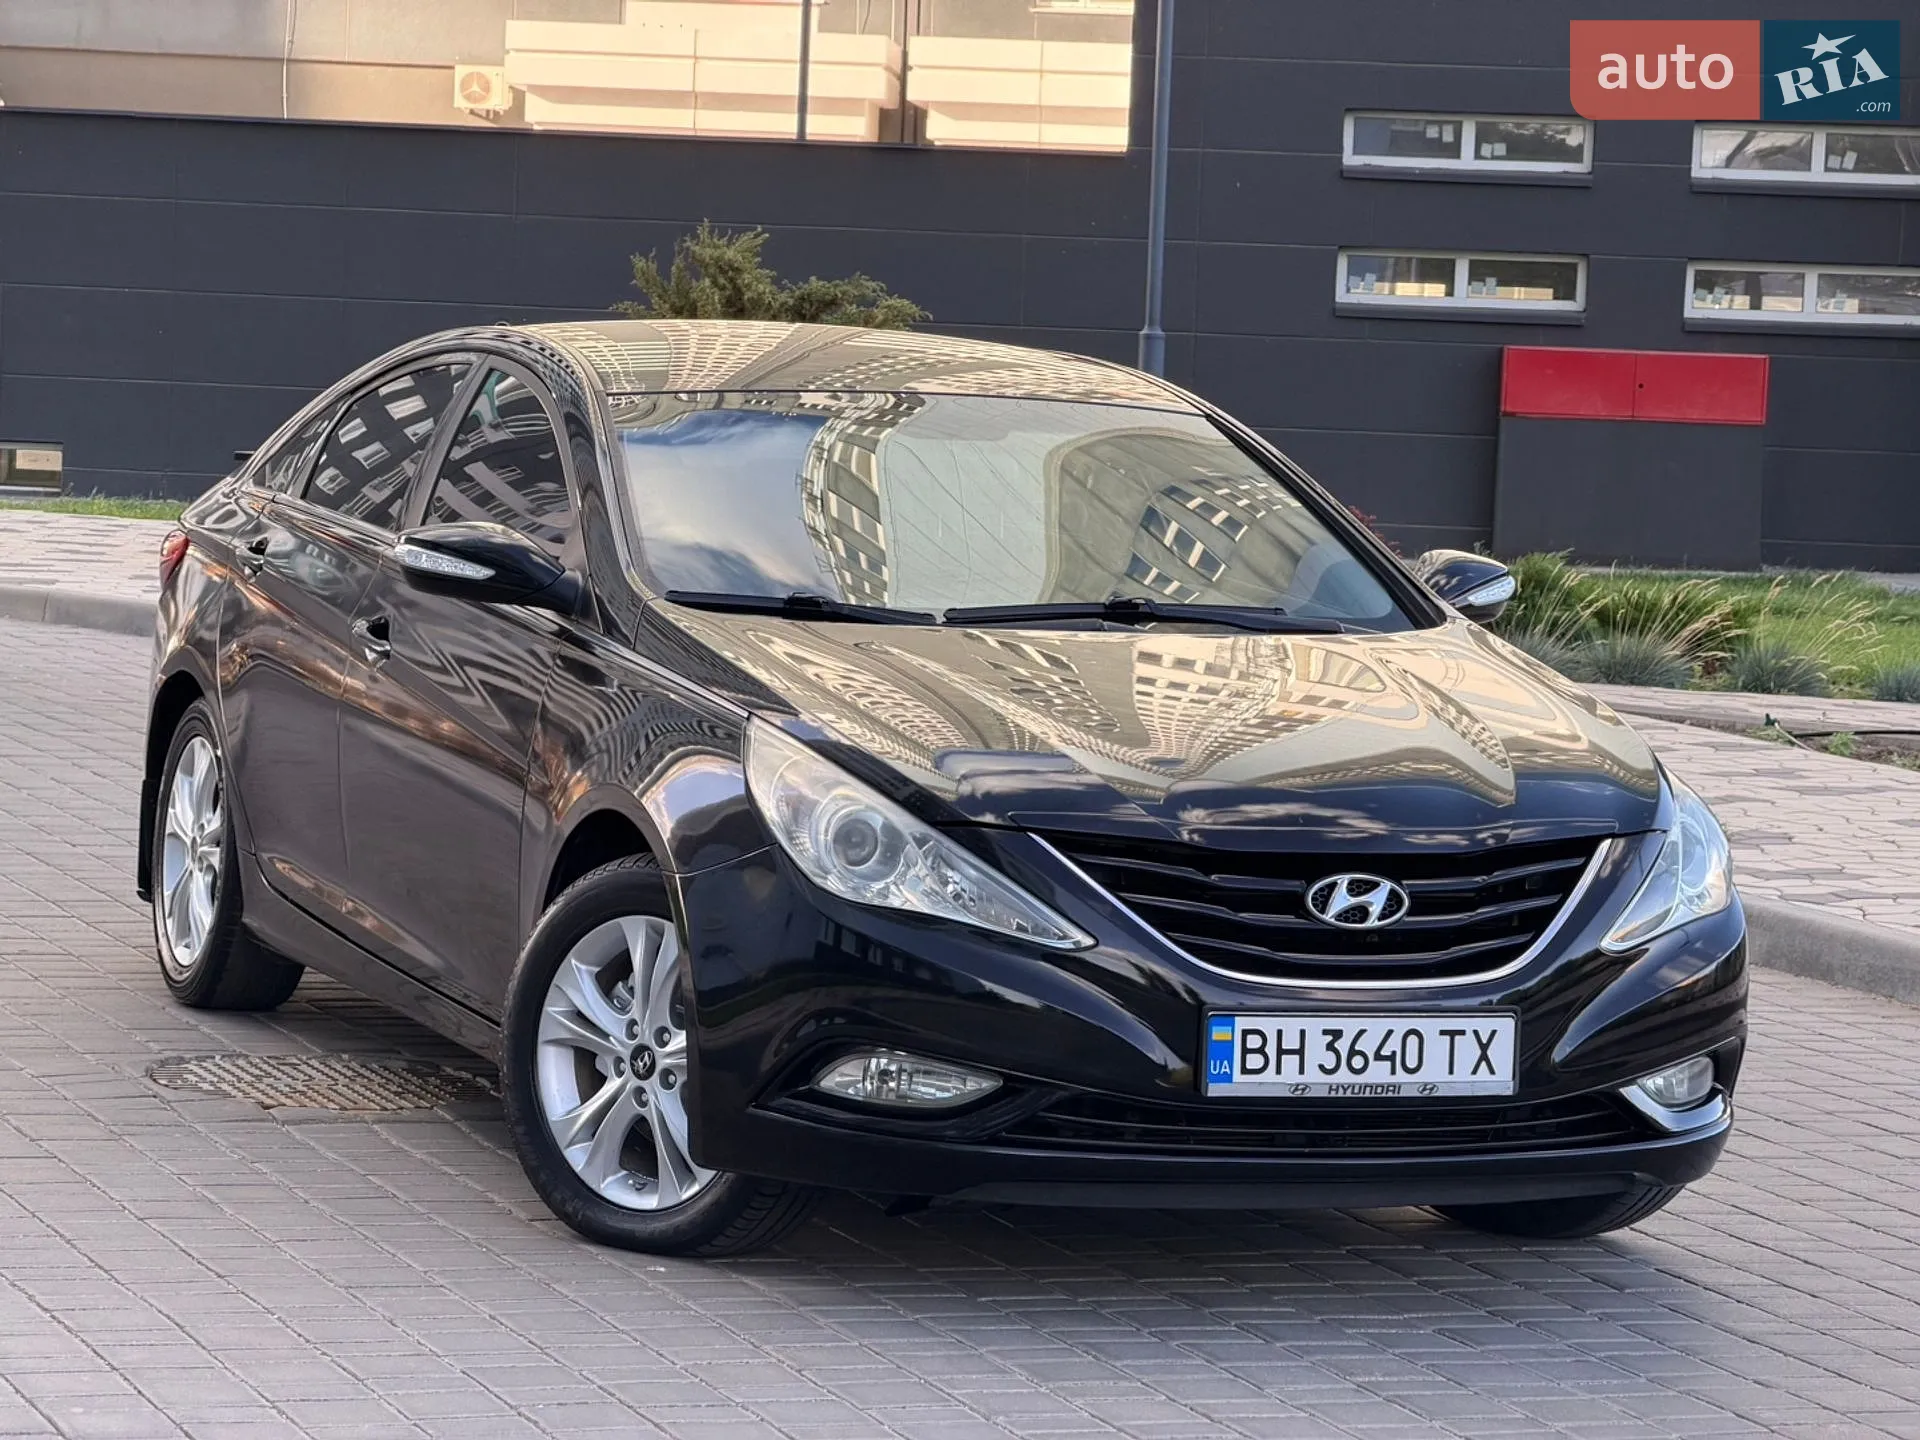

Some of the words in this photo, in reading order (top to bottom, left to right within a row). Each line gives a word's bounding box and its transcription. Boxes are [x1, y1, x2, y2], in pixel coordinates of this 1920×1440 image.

[1239, 1028, 1307, 1077] BH
[1317, 1027, 1425, 1077] 3640
[1439, 1028, 1499, 1077] TX
[1209, 1059, 1232, 1075] UA
[1327, 1083, 1402, 1096] HYUNDAI
